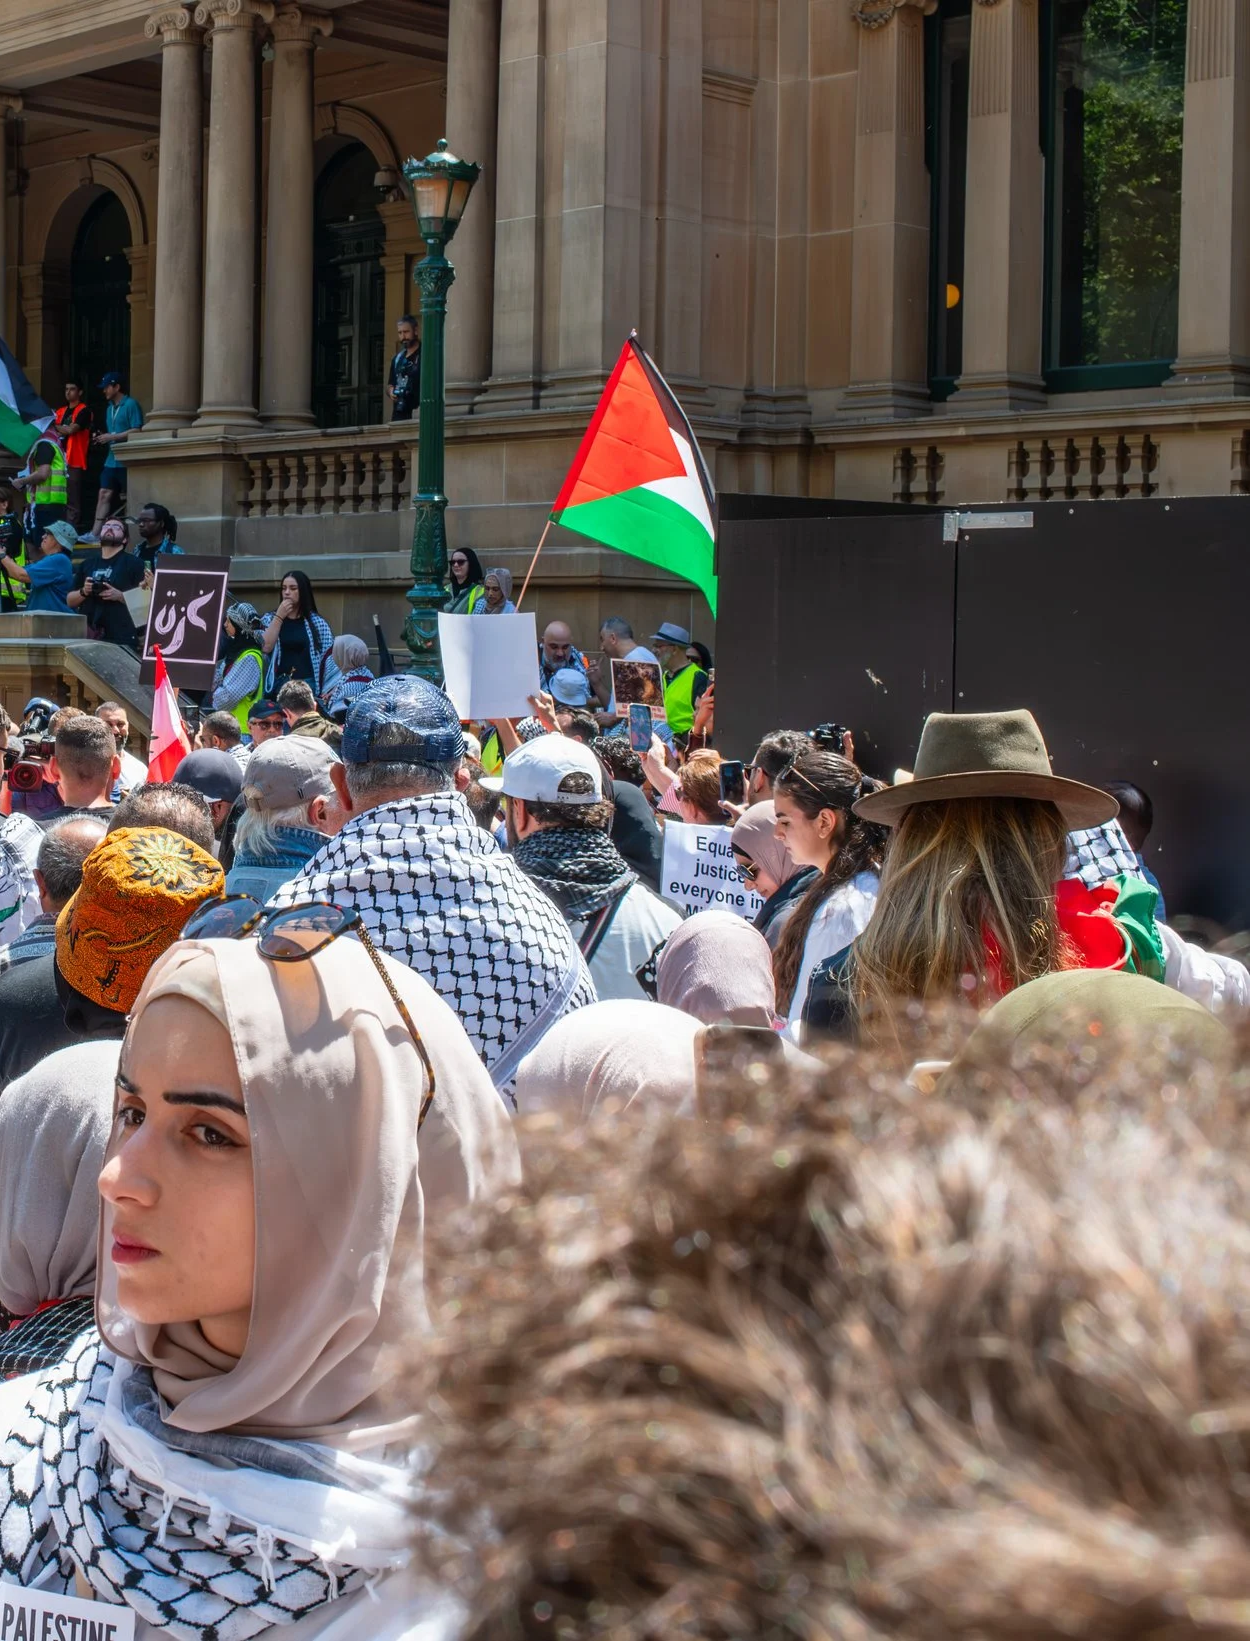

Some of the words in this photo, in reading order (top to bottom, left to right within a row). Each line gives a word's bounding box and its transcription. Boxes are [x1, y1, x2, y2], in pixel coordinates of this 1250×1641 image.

[154, 588, 216, 656] غزة
[696, 836, 734, 858] Equa
[670, 881, 746, 907] everyone
[750, 893, 764, 909] in
